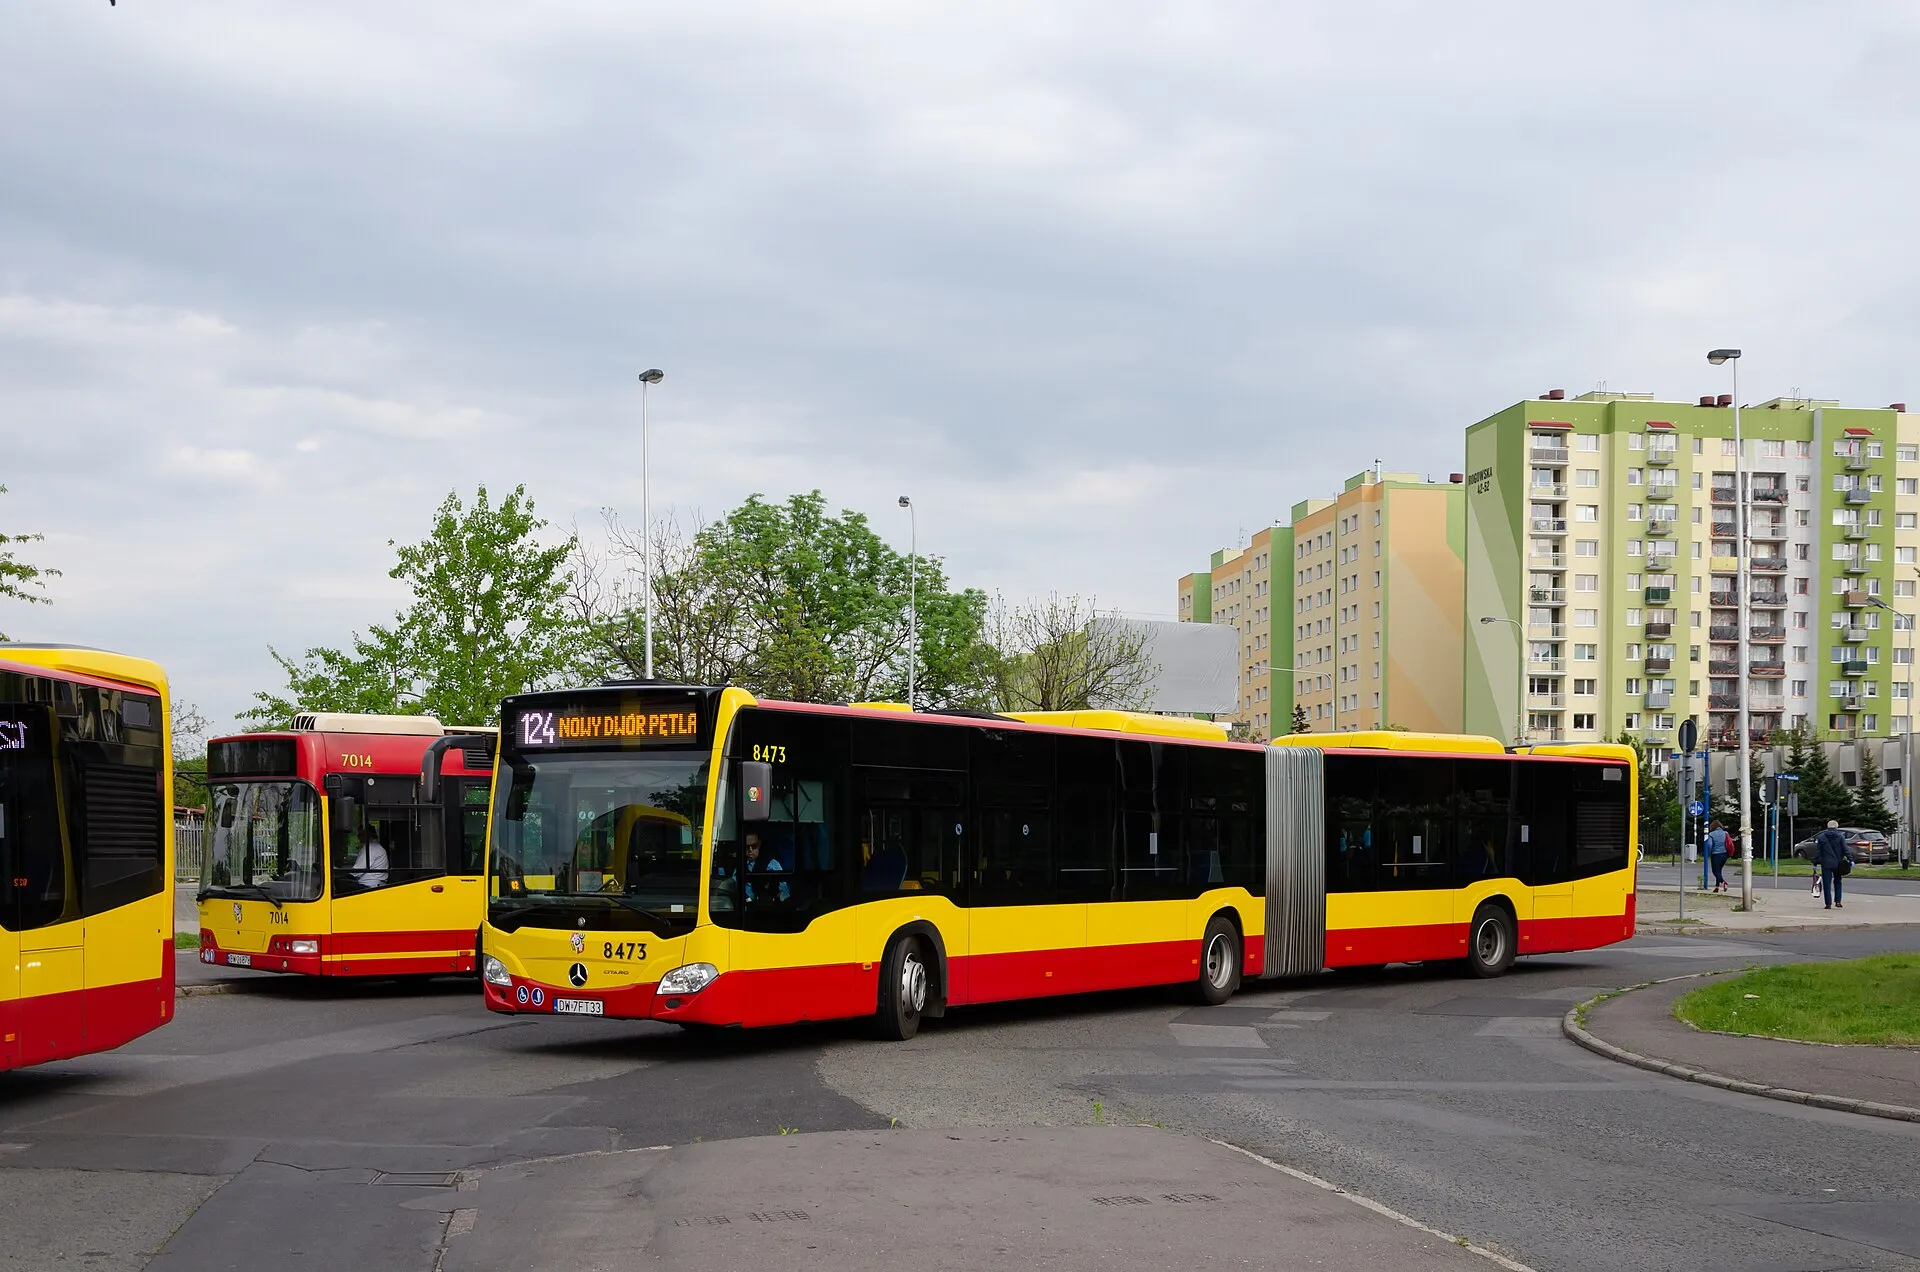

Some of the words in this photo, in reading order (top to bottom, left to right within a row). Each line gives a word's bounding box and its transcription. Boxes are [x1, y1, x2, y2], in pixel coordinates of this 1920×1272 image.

[521, 712, 555, 744] 124
[559, 716, 601, 737] NOWY
[604, 713, 645, 735] DWÓR
[649, 713, 696, 736] PĘTLA
[341, 753, 372, 767] 7014
[753, 744, 786, 763] 8473
[270, 911, 289, 924] 7014
[603, 941, 648, 960] 8473
[558, 999, 570, 1012] DW
[573, 1000, 601, 1014] 7FT33
